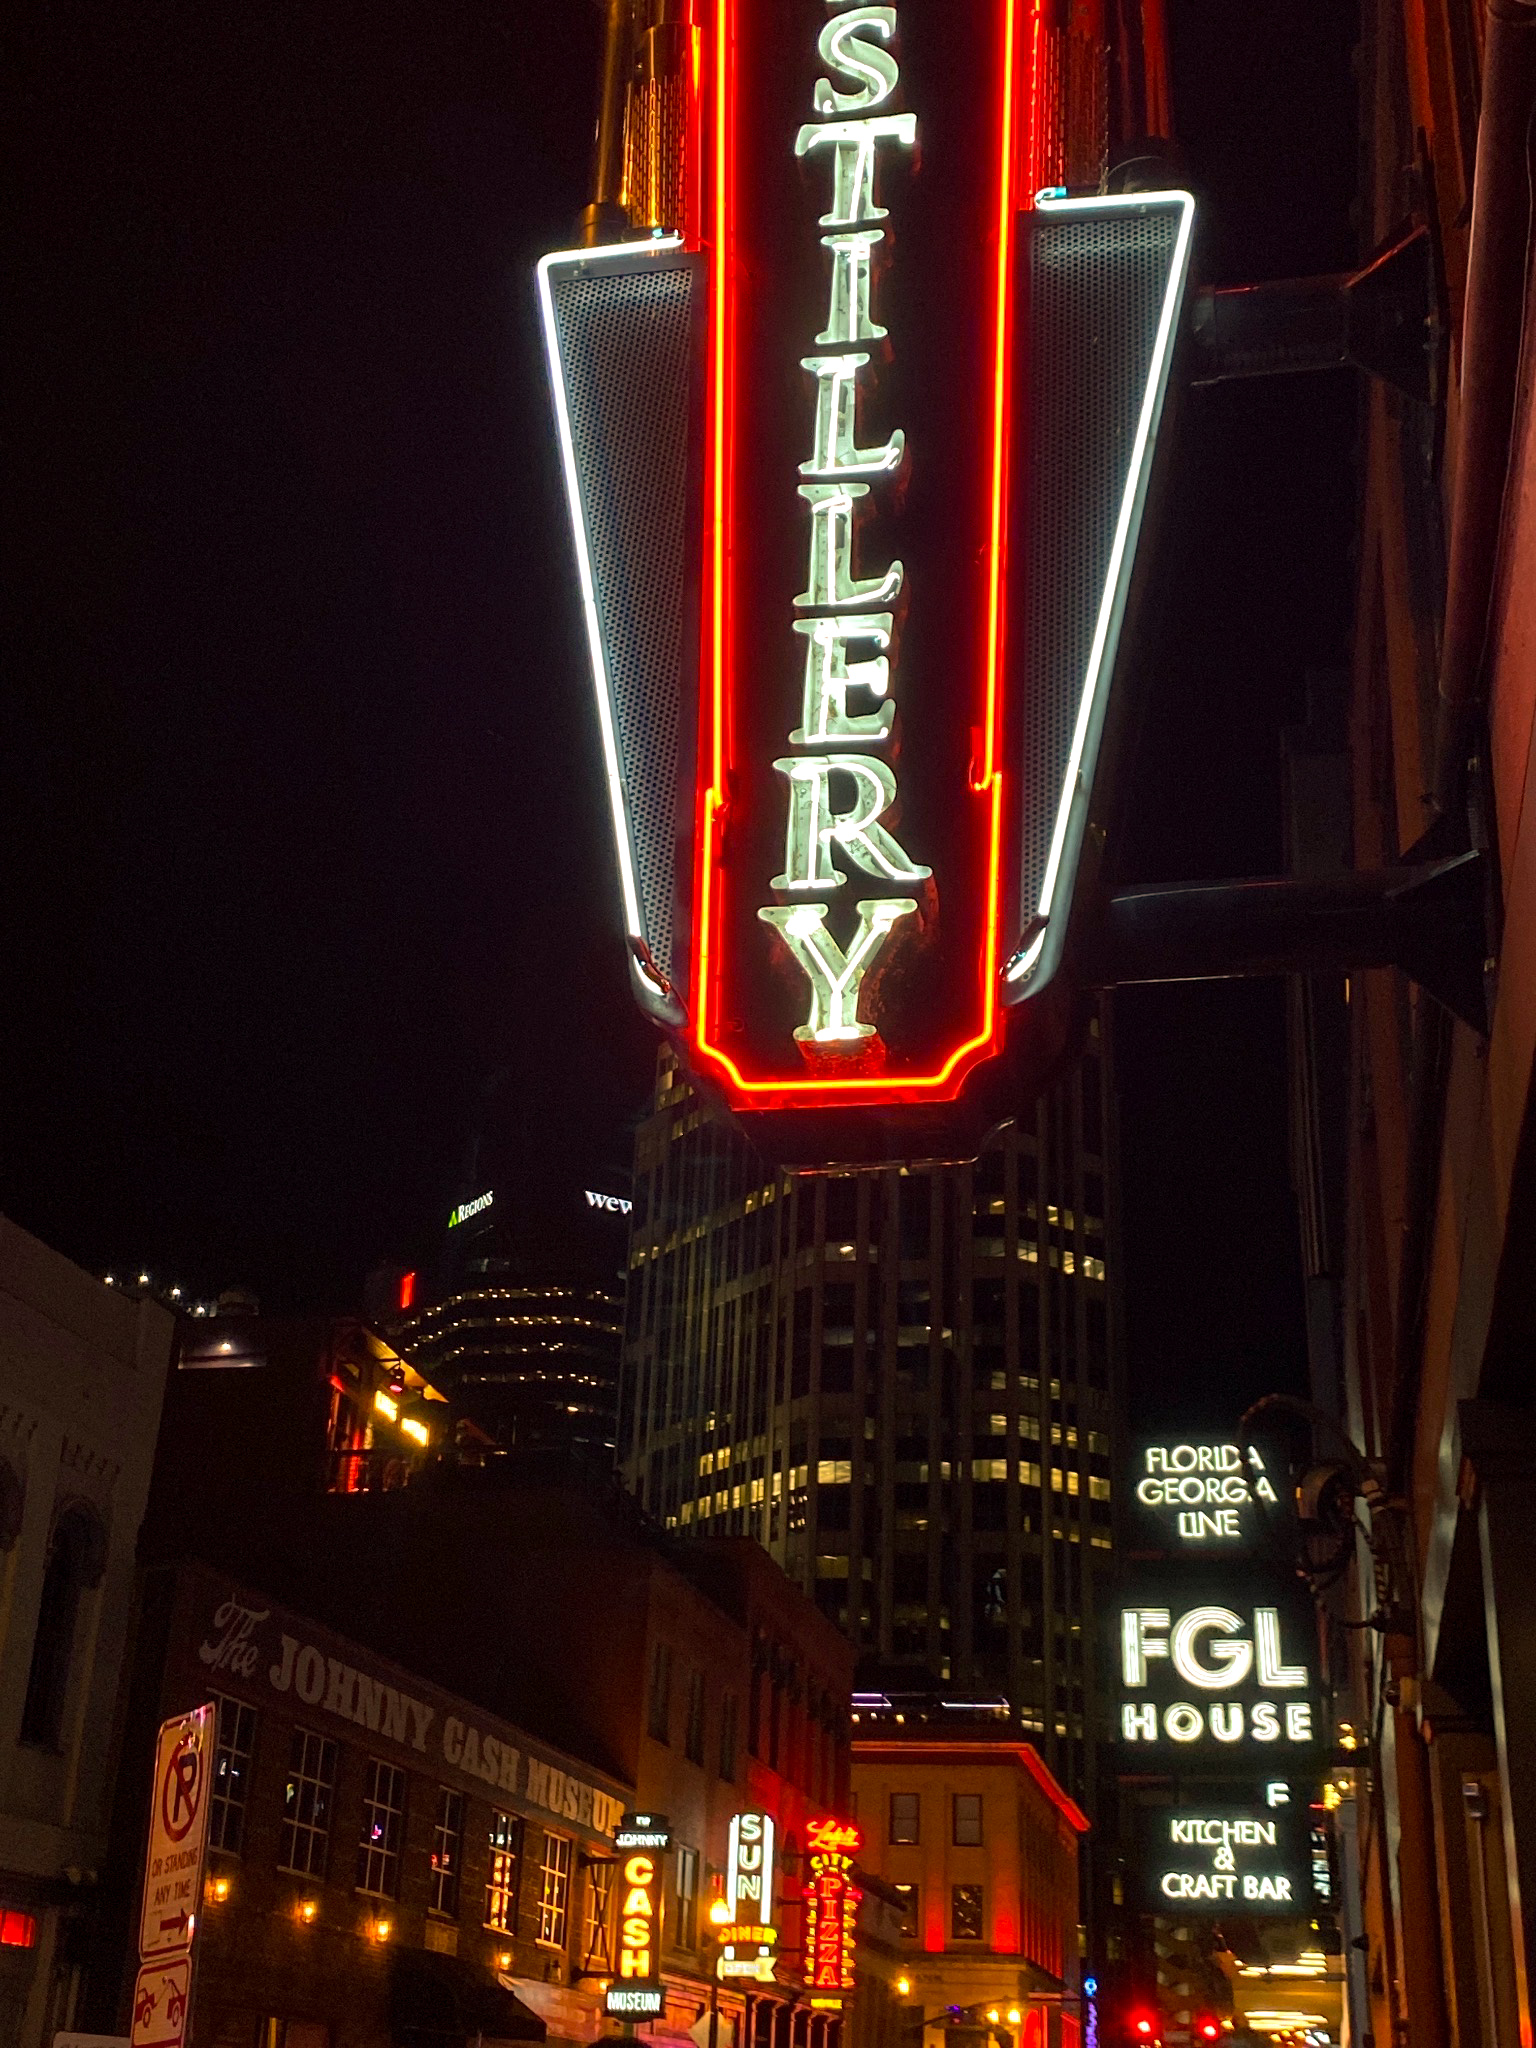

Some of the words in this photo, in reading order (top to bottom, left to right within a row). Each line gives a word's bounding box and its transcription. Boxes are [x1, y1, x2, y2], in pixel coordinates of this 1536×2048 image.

[457, 1190, 494, 1223] REGIONS
[1145, 1444, 1266, 1473] FLORIDA
[1136, 1476, 1278, 1505] GEORGA
[1177, 1509, 1242, 1538] LINE
[1121, 1605, 1308, 1688] FGL
[200, 1593, 270, 1678] The
[269, 1634, 435, 1753] JOHNNY
[443, 1716, 521, 1793] CASH
[525, 1756, 626, 1838] MUSEUM
[1121, 1701, 1313, 1742] HOUSE
[616, 1833, 668, 1847] JOHNNY
[1170, 1819, 1277, 1846] KITCHEN
[152, 1857, 163, 1878] OR
[164, 1849, 198, 1875] STANDING
[737, 1814, 762, 1900] SUN
[810, 1853, 854, 1870] CITY
[1213, 1845, 1236, 1872] &
[154, 1884, 171, 1905] ANY
[174, 1879, 191, 1902] TIME
[1161, 1872, 1238, 1899] CRAFT
[1242, 1874, 1293, 1901] BAR
[621, 1856, 655, 1978] CASH
[818, 1876, 842, 1986] PIZZA
[718, 1925, 778, 1944] DINER
[606, 1991, 661, 2013] MUSEUM
